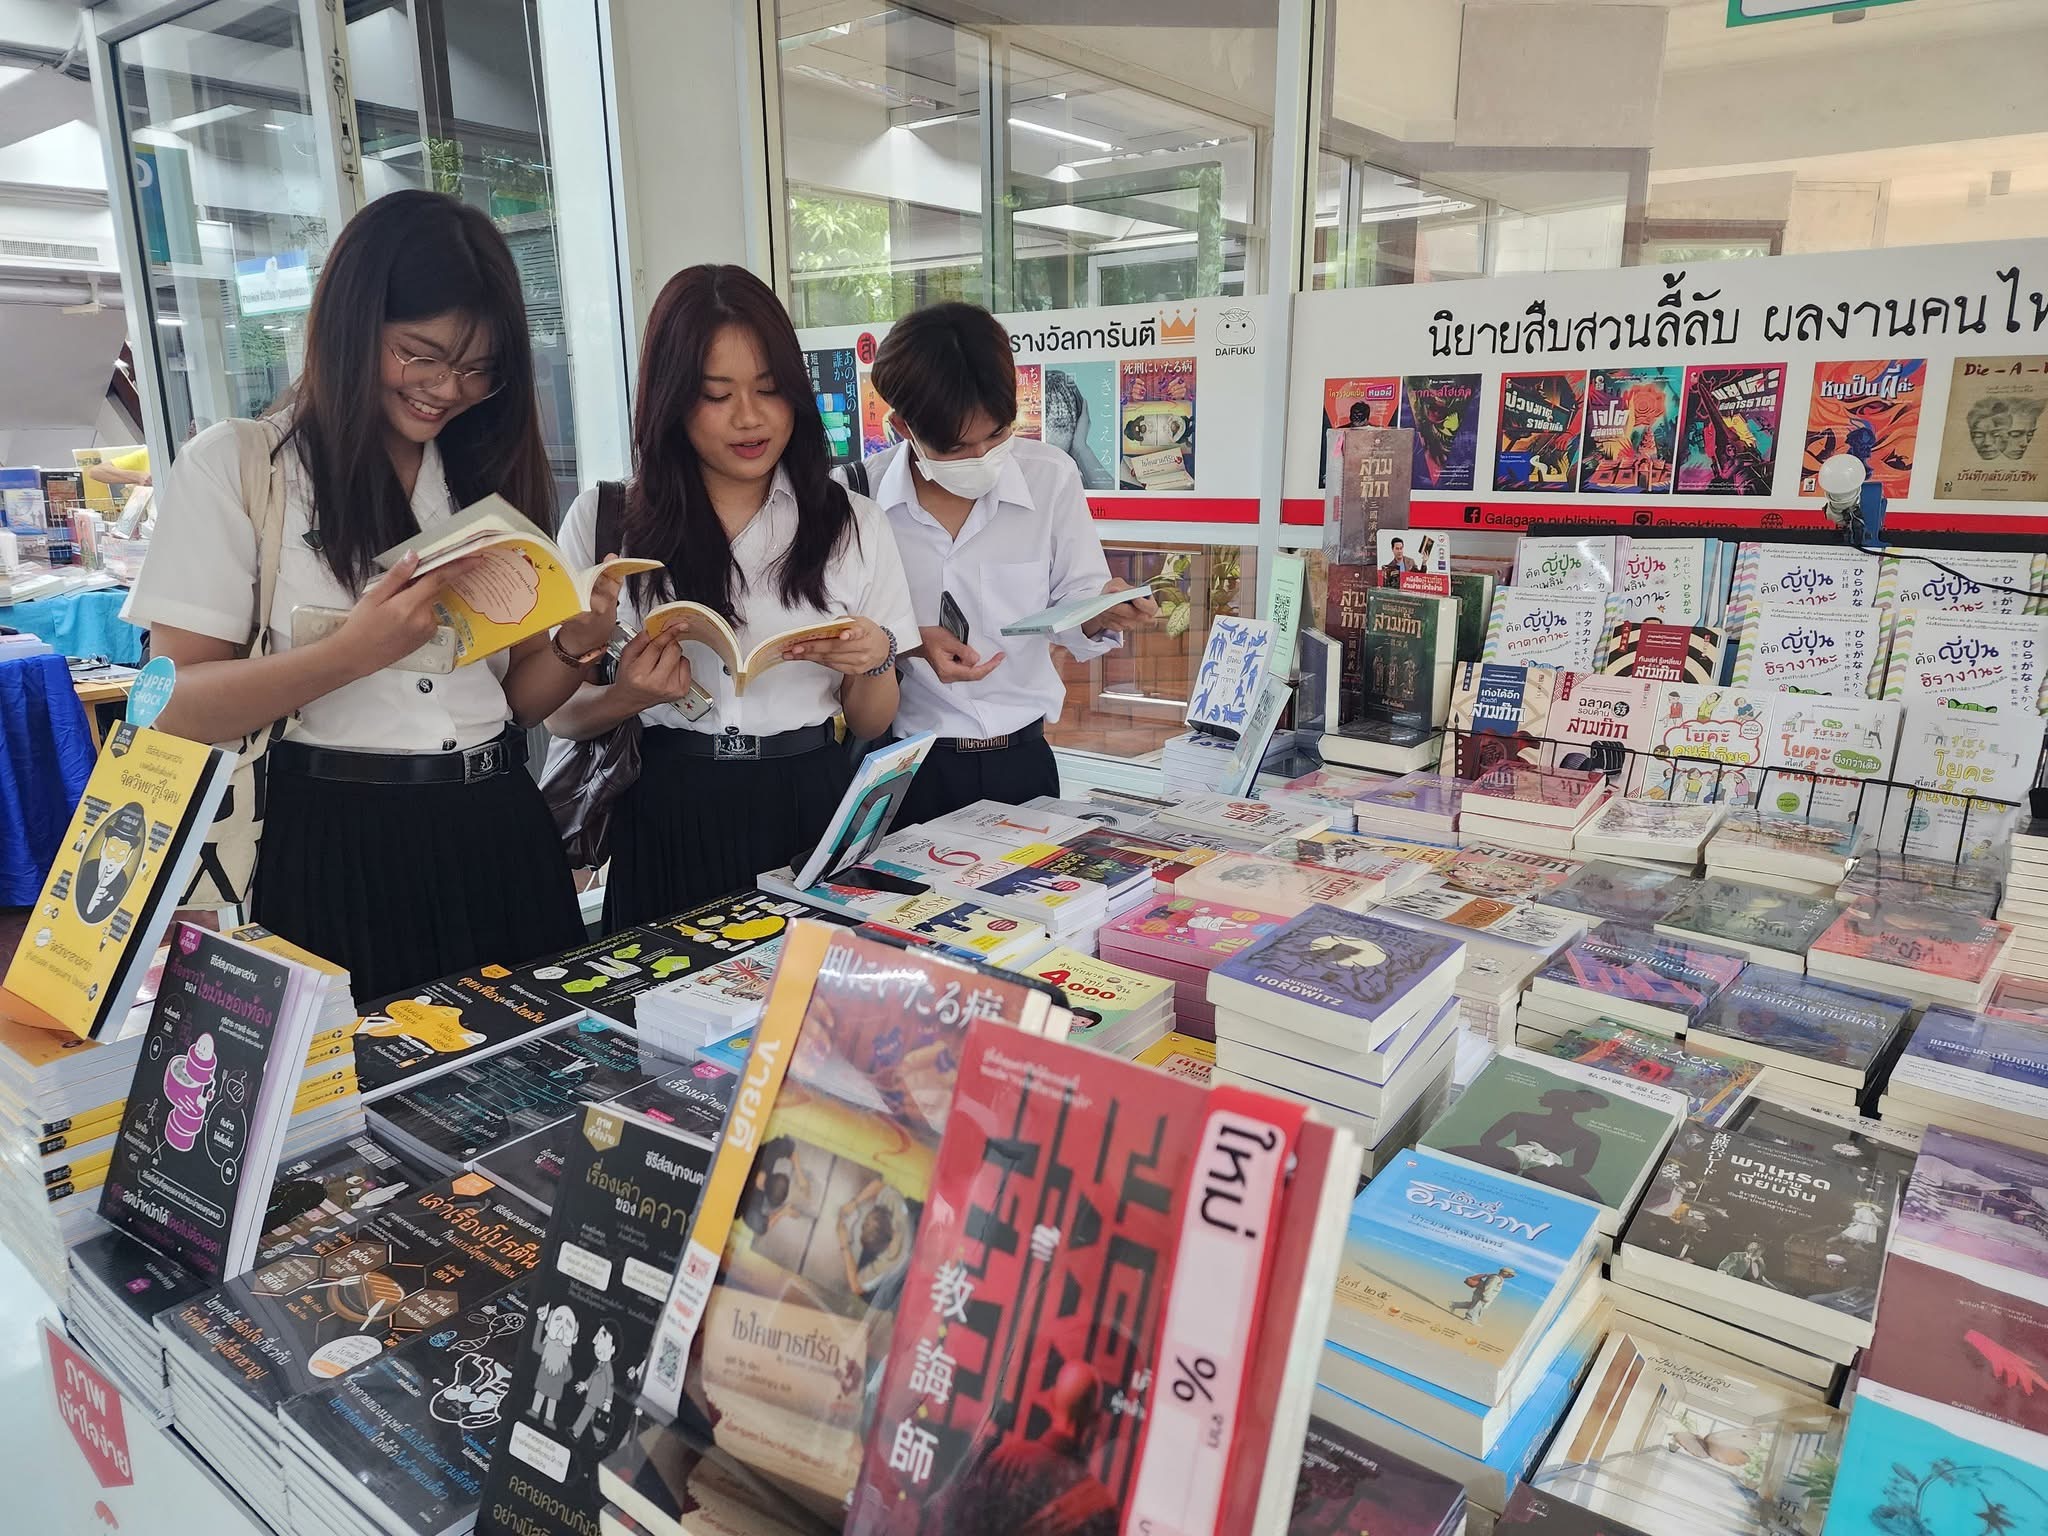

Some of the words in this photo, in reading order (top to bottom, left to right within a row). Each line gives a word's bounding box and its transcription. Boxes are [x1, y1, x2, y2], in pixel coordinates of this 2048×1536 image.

[1428, 271, 1742, 358] นิยายสืบสวนลี้ลับ
[1010, 318, 1156, 354] รางวัลการันตี
[832, 351, 844, 381] 誰か
[1215, 346, 1257, 357] DAIFUKU
[844, 350, 857, 412] あの頃の
[1123, 360, 1193, 375] 死刑にいたる病
[1820, 363, 1915, 400] หนูเป็นผีค่ะ
[1964, 361, 1990, 377] Die
[1359, 456, 1393, 477] สาม
[1360, 474, 1390, 499] ก๊ก
[1484, 513, 1544, 527] Galagaan
[1541, 552, 1582, 577] ญี่ปุ่น
[1760, 582, 1778, 594] คัด
[1781, 565, 1834, 595] ญี่ปุ่น
[1900, 590, 1920, 602] คัด
[1923, 573, 1982, 603] ญี่ปุ่น
[1373, 612, 1422, 639] สามก๊ก
[1505, 621, 1522, 633] คัด
[1523, 607, 1568, 634] ญี่ปุ่น
[1507, 631, 1570, 651] คาตาคานะ
[1760, 643, 1778, 655] คัด
[1781, 626, 1835, 656] ญี่ปุ่น
[1915, 653, 1936, 665] คัด
[1938, 635, 2000, 667] ญี่ปุ่น
[1634, 664, 1681, 681] สามก๊ก
[1764, 653, 1838, 676] ฮิรางานะ
[1920, 665, 2004, 688] ฮิรางานะ
[135, 668, 174, 692] SUPER
[1481, 687, 1520, 700] เก่งได้อีก
[134, 688, 164, 708] SHOCK
[1471, 702, 1526, 722] สามก๊ก
[1578, 706, 1610, 718] รอบด้าน
[1579, 696, 1611, 710] ฉลาด
[1566, 717, 1629, 740] สามก๊ก
[1684, 725, 1729, 744] โยคะ
[1781, 733, 1832, 761] โยคะ
[1833, 753, 1881, 771] ยิ่งกว่าเดิม
[1935, 749, 1995, 783] โยคะ
[120, 769, 181, 804] จิตวิทยารู้ใจคน
[184, 981, 197, 994] ของ
[197, 971, 273, 1028] ไขมันช่องท้อง
[1254, 974, 1344, 1006] HOROWITZ
[1282, 978, 1324, 993] ANTHONY
[729, 1038, 782, 1154] ขายดี
[586, 1160, 640, 1202] เรื่องเล่า
[1199, 1124, 1278, 1242] ใหม่
[1730, 1153, 1831, 1192] พาเหรด
[1733, 1172, 1817, 1203] เงียบงัน
[1753, 1170, 1803, 1188] แห่งความ
[615, 1195, 637, 1217] ของ
[637, 1196, 693, 1239] ควา
[1405, 1179, 1553, 1241] อิสรภาพ
[417, 1192, 541, 1271] เล่าเรื่องโปรตีน
[1336, 1274, 1361, 1289] รั้งที่
[179, 1305, 270, 1381] โปรตีนโดยผู้เชี่ยวชาญ!
[204, 1293, 293, 1366] ไขทุกข้อข้องใจเกี่ยวกับ
[731, 1308, 841, 1367] ไซโคพาธที่รัก
[888, 1262, 976, 1485] 教誨師
[1173, 1354, 1218, 1404] %
[1646, 1355, 1732, 1389] แฟ้มปริศนาลับ
